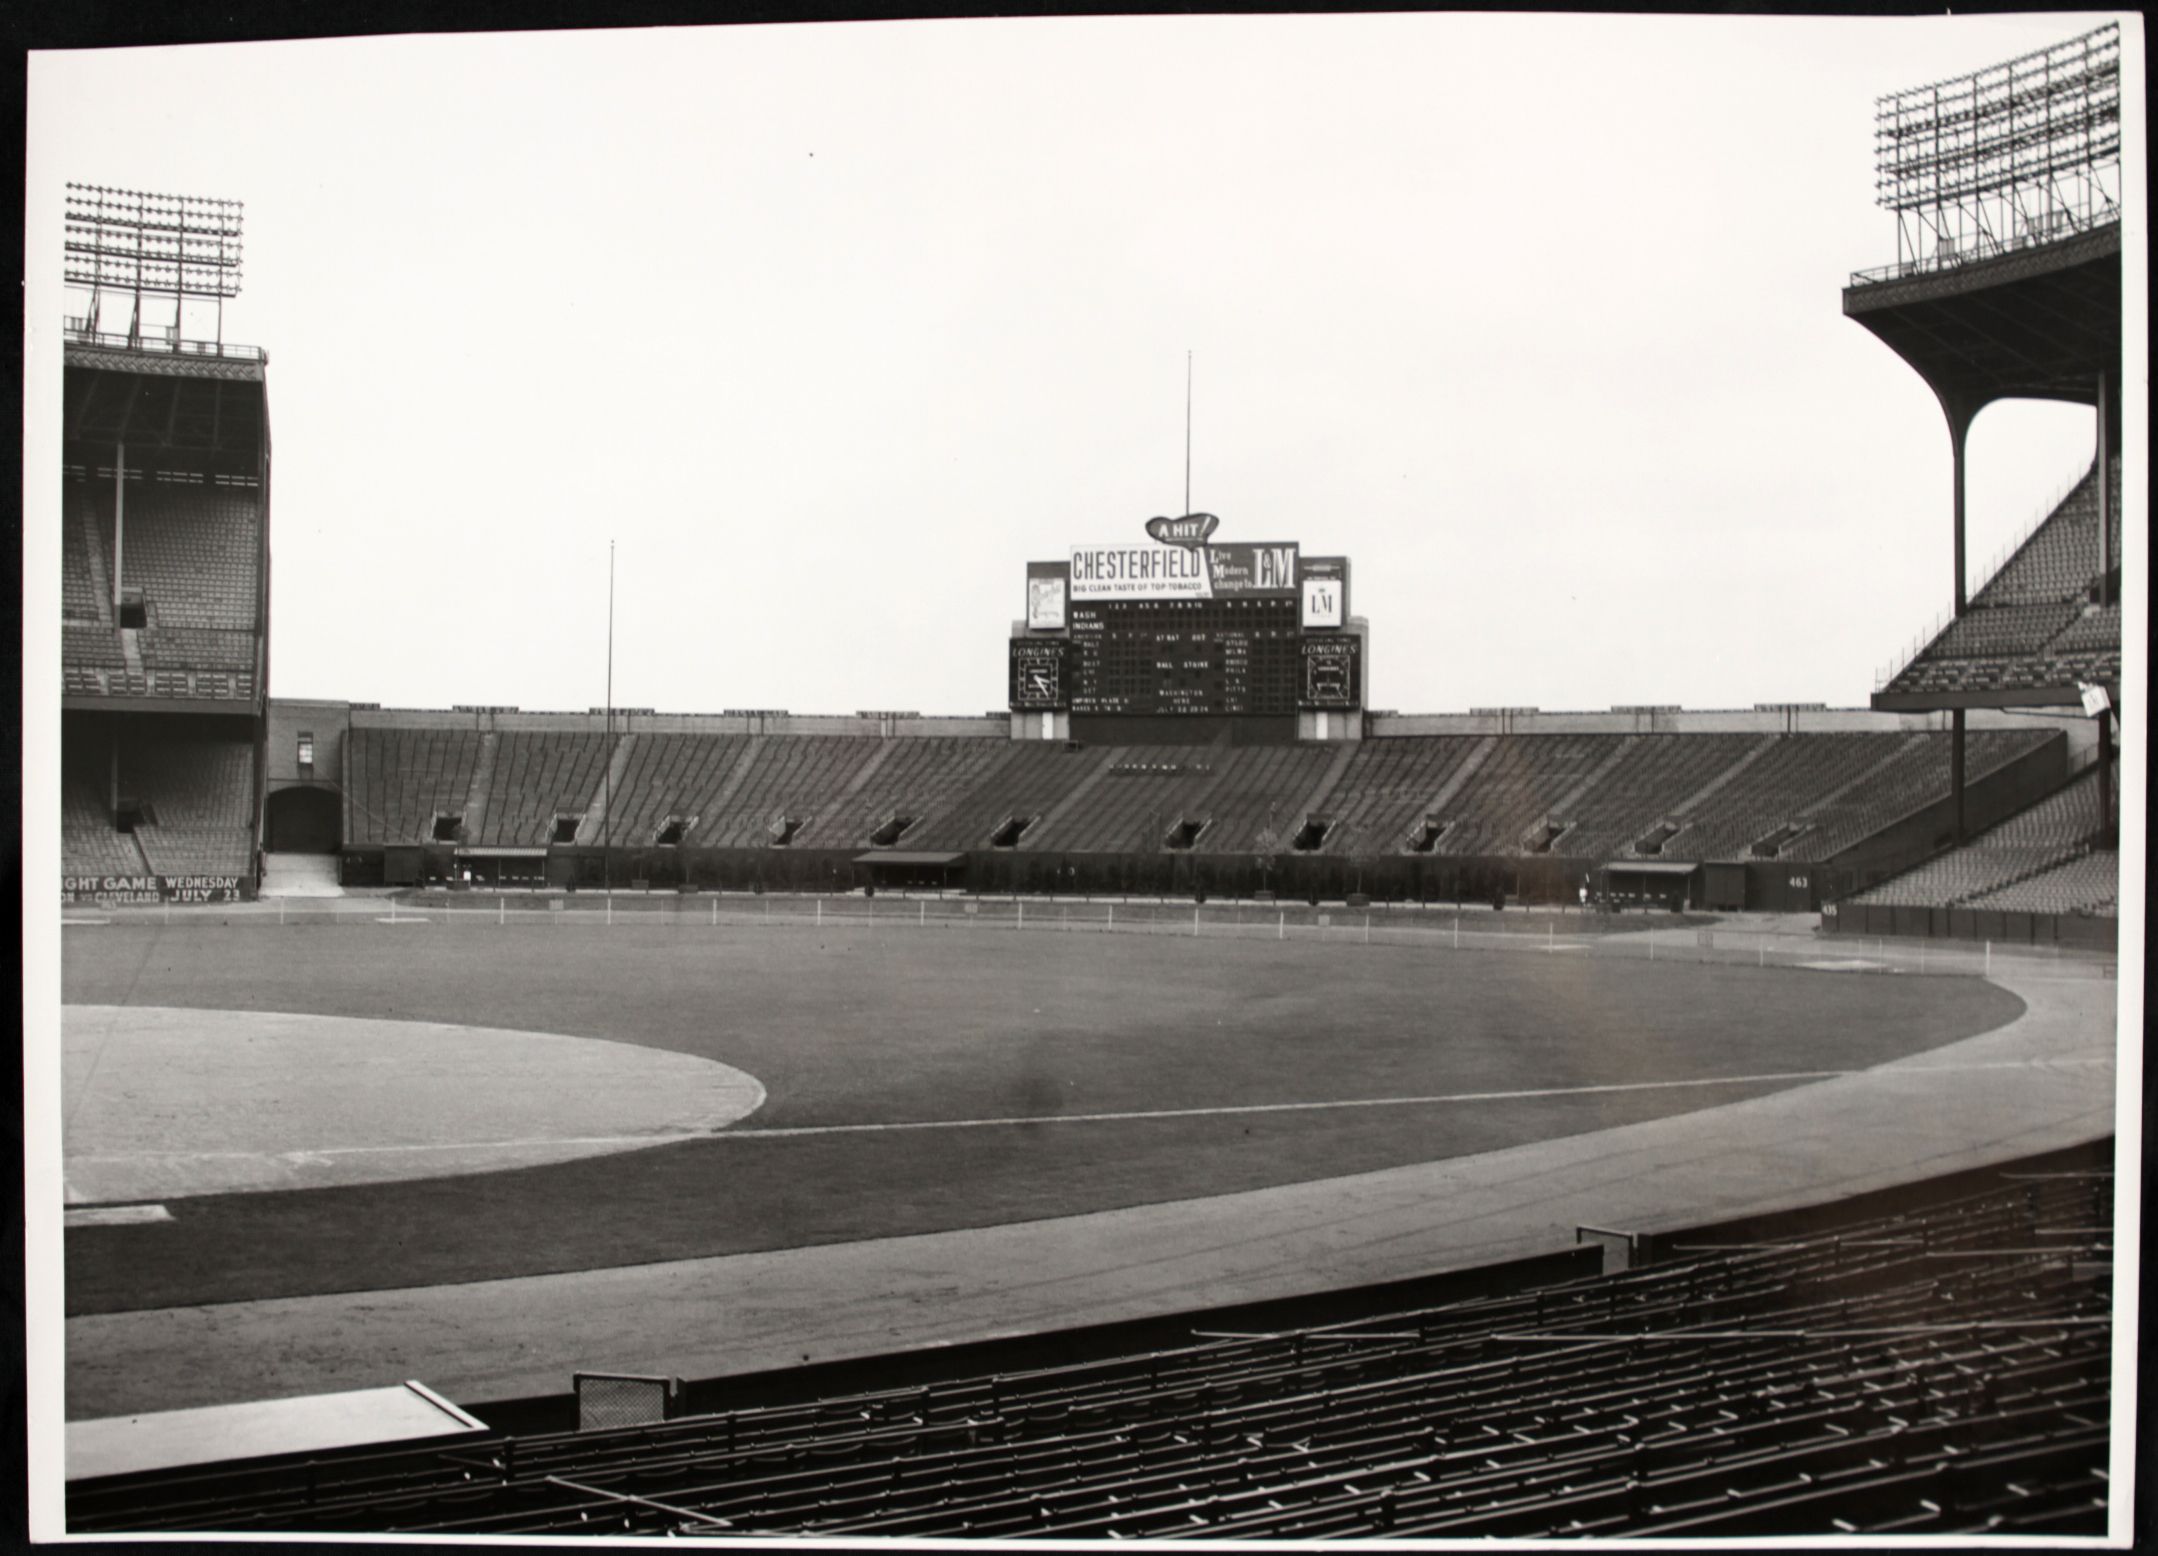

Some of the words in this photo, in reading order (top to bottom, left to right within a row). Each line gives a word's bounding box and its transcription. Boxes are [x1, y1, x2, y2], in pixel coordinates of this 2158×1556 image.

[1158, 523, 1169, 537] A
[1172, 516, 1212, 537] HIT!
[1210, 549, 1232, 563] Live
[1073, 549, 1200, 580] CHESTERFIELD
[1252, 548, 1296, 589] L&M
[1213, 564, 1249, 579] Modern
[1073, 584, 1087, 593] BIG
[1088, 583, 1112, 592] CLEAN
[1114, 583, 1136, 592] TASTE
[1137, 583, 1148, 591] OF
[1151, 582, 1166, 591] TOP
[1168, 582, 1202, 591] TOBACCO
[1214, 578, 1243, 592] change
[1244, 578, 1253, 588] to
[1073, 611, 1097, 619] WASH
[1072, 621, 1104, 630] INDIANS
[1012, 647, 1065, 657] LONGINES
[1301, 644, 1357, 655] LONGINES
[1156, 661, 1173, 669] BALL
[1183, 661, 1208, 669] STRIKE
[1159, 689, 1203, 697] WASHINGTON
[103, 877, 157, 891] GAME
[165, 877, 238, 889] WEDNESDAY
[1789, 876, 1808, 889] 463
[95, 891, 160, 904] CLEVELAND
[171, 889, 212, 901] JULY
[224, 890, 240, 901] 23
